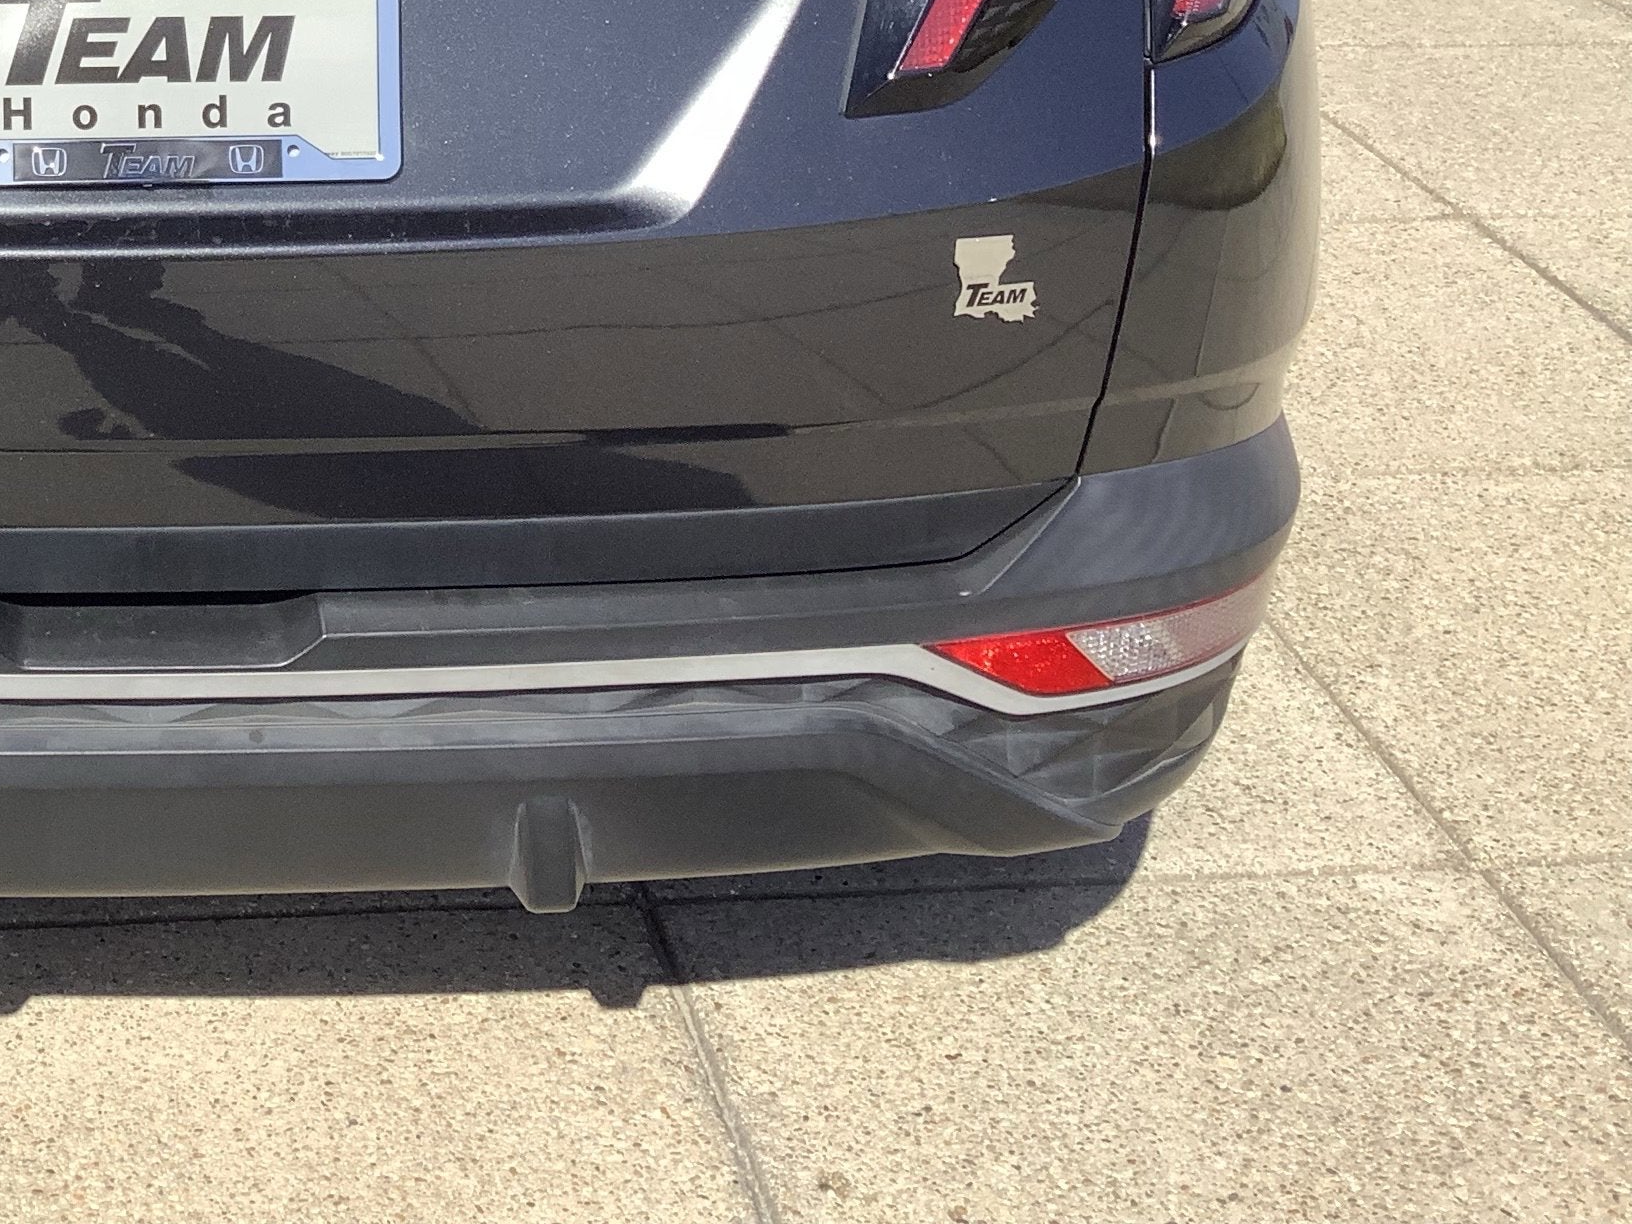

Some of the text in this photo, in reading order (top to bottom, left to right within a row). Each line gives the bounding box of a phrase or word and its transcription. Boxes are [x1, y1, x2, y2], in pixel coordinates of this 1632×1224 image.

[2, 94, 292, 131] Honda
[100, 142, 196, 179] TEAM
[966, 282, 1028, 308] TEAM
